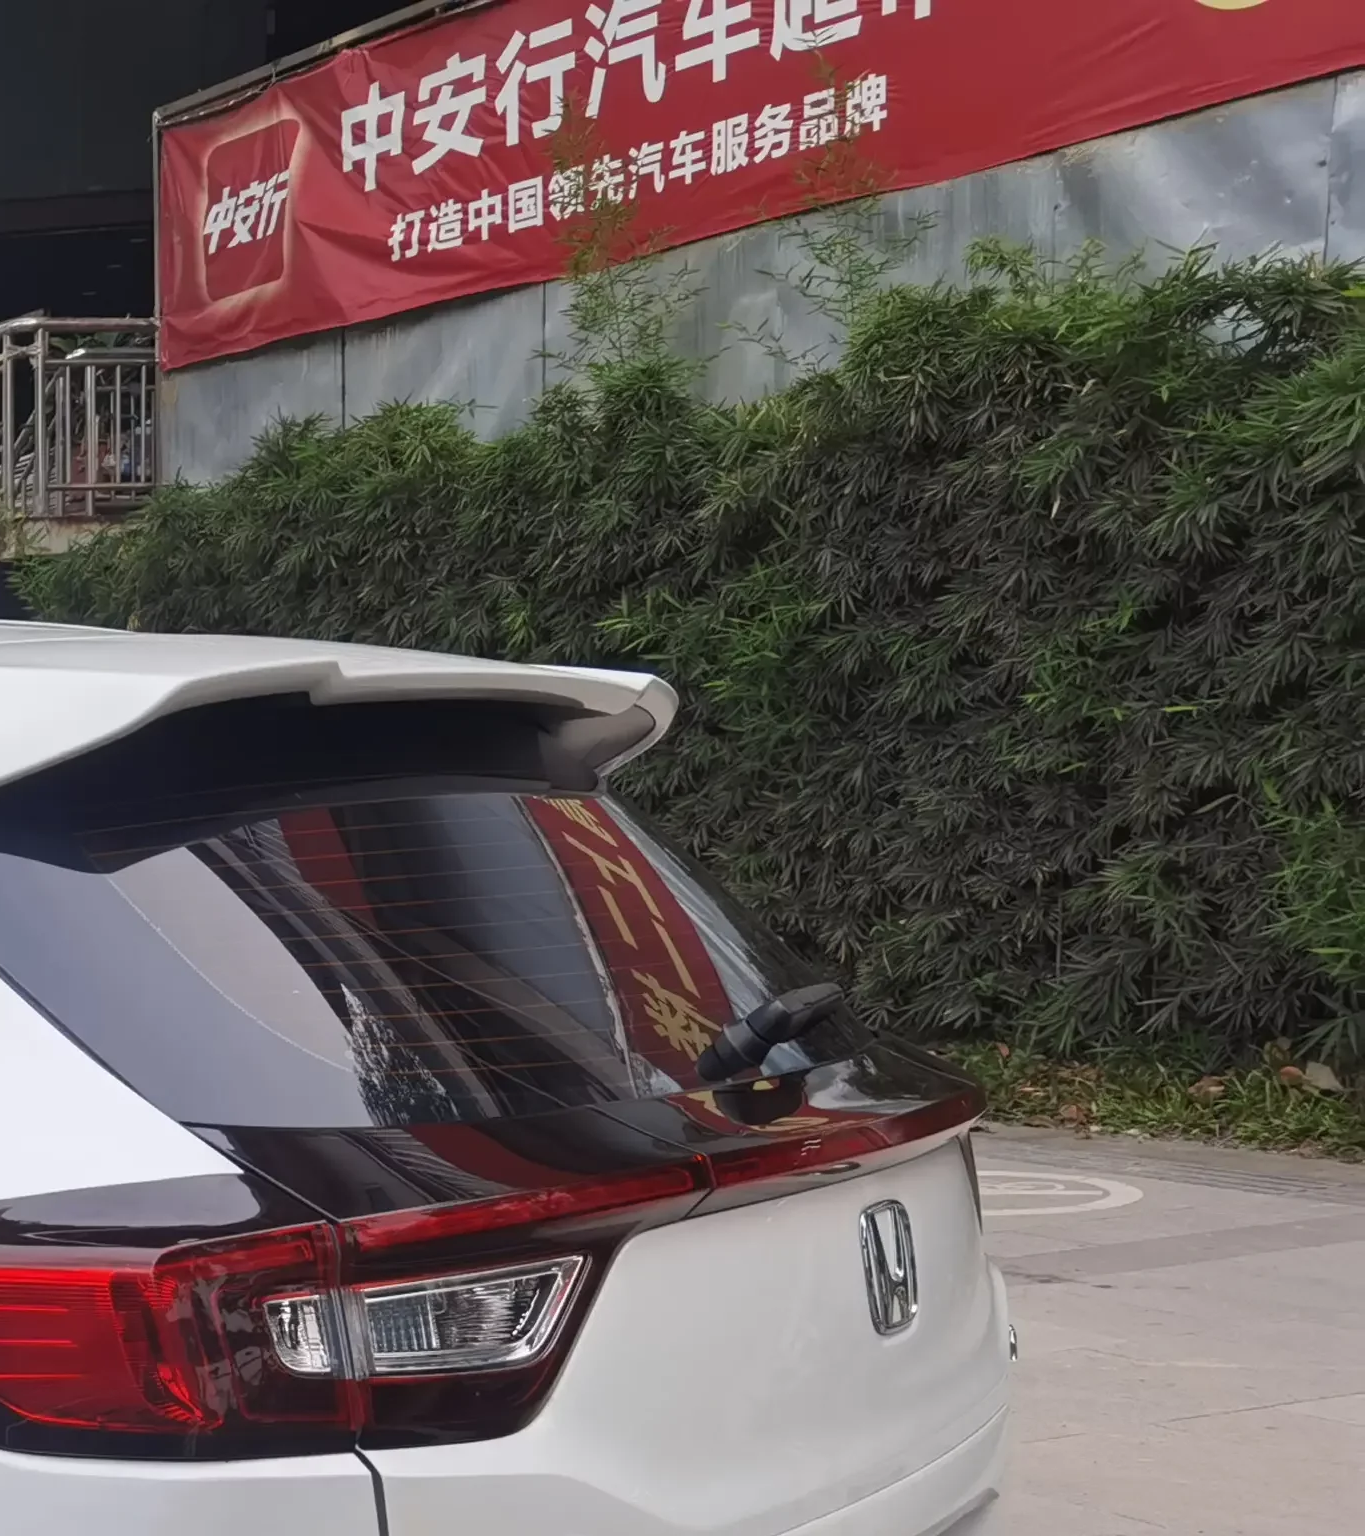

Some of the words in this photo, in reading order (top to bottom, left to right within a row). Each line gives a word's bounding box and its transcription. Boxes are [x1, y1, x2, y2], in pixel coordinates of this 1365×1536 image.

[341, 0, 932, 192] 中安行汽车
[387, 73, 888, 263] 打造中国领先汽车服务品牌
